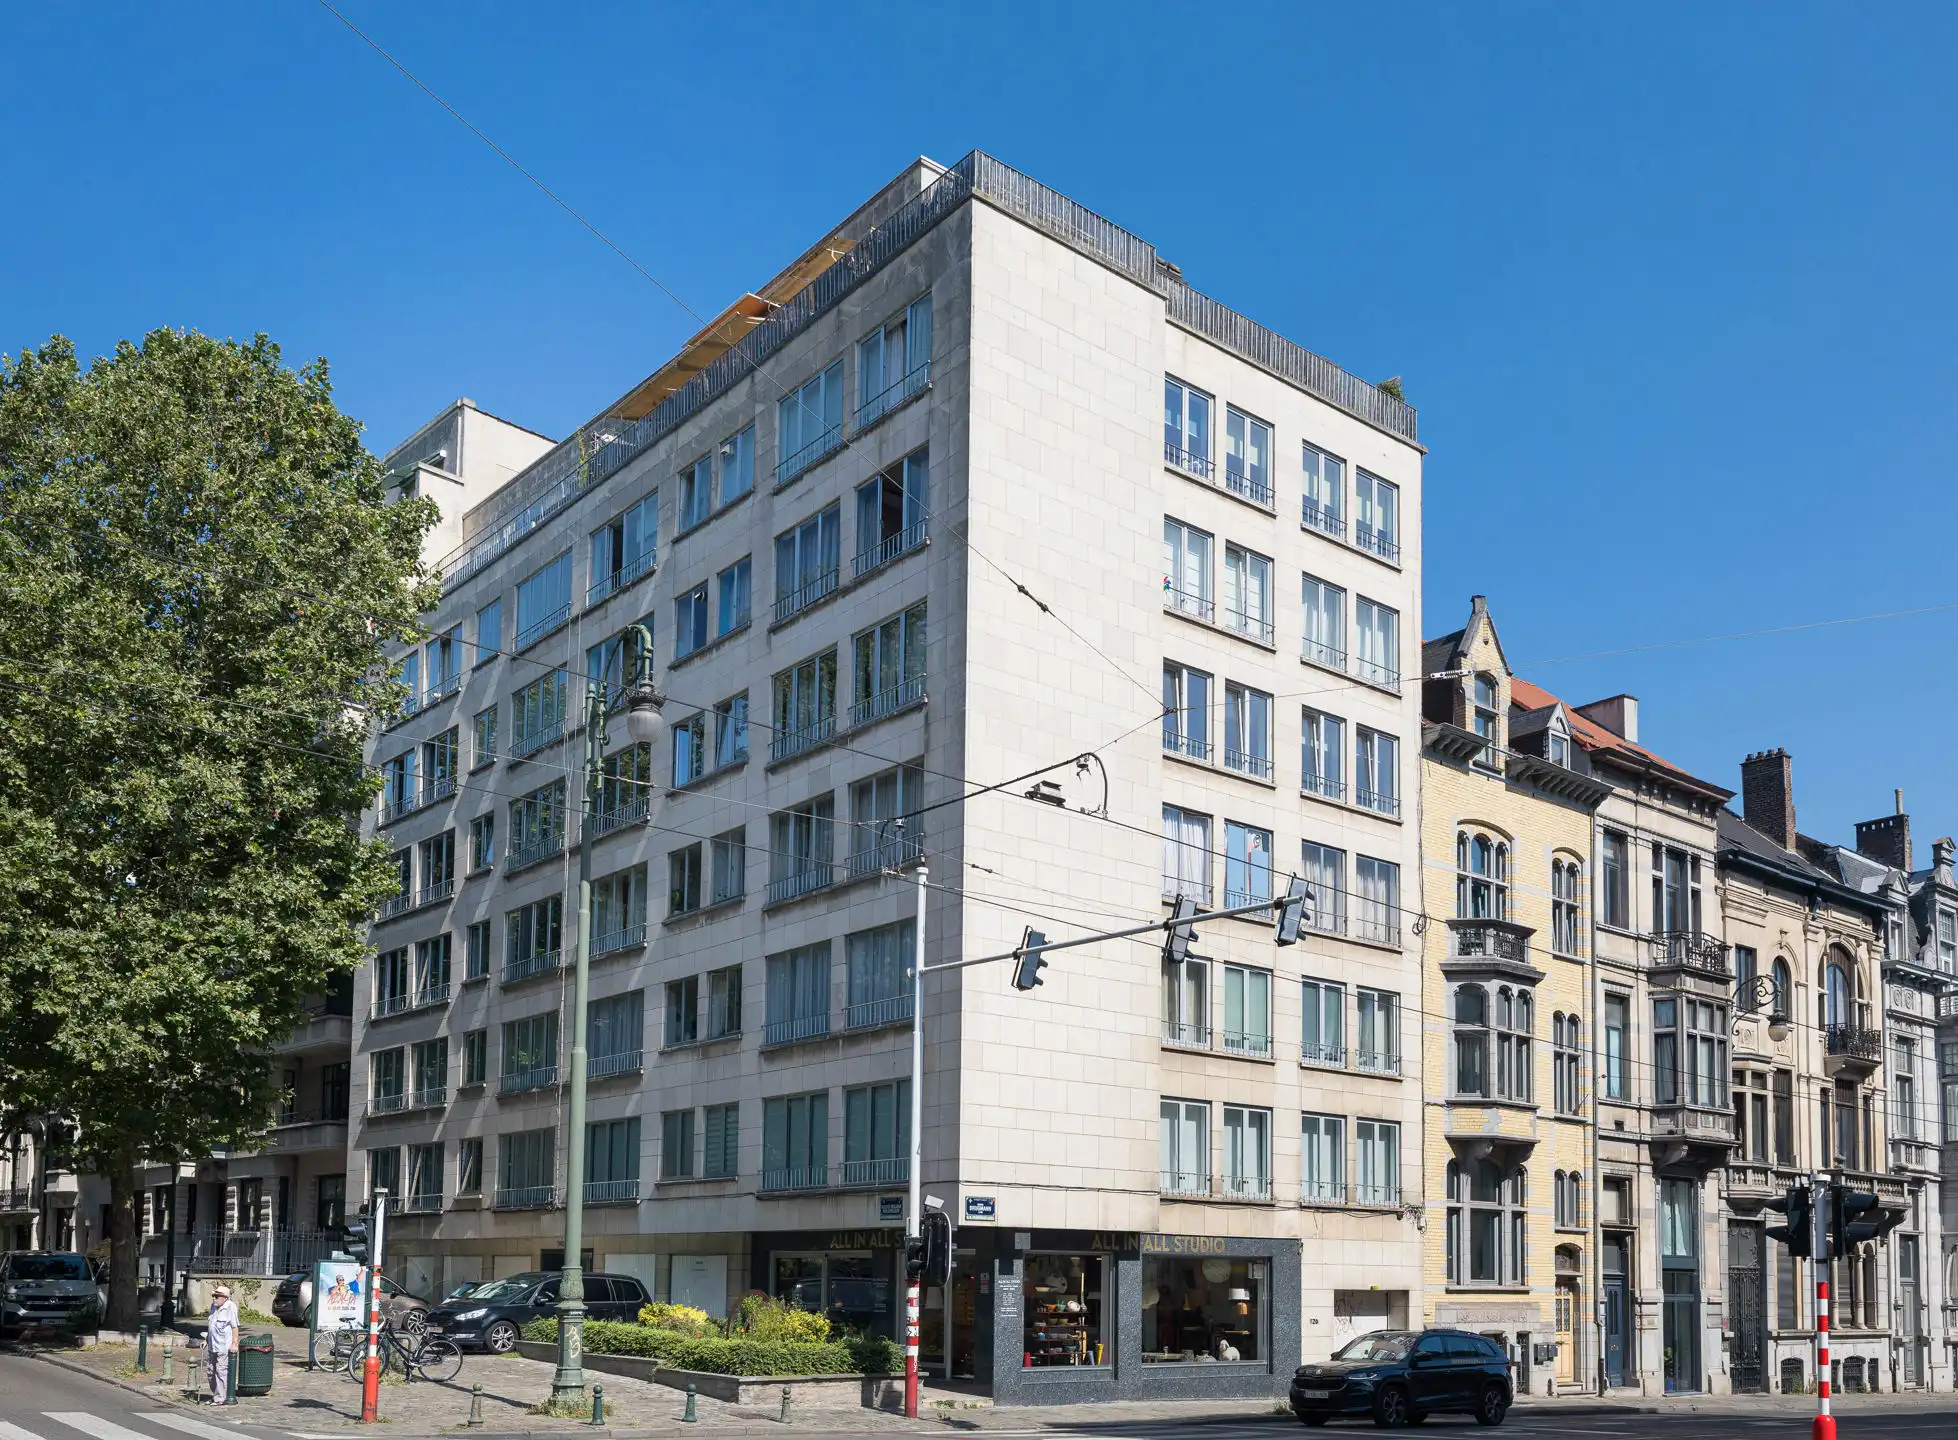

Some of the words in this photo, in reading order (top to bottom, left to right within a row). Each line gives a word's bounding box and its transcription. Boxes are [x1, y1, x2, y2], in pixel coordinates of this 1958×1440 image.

[830, 1232, 851, 1249] ALL
[854, 1231, 866, 1249] IN
[869, 1231, 891, 1248] ALL
[1091, 1233, 1119, 1250] ALL
[1124, 1233, 1138, 1251] IN
[1143, 1234, 1170, 1252] ALL
[1174, 1235, 1225, 1253] STUDIO
